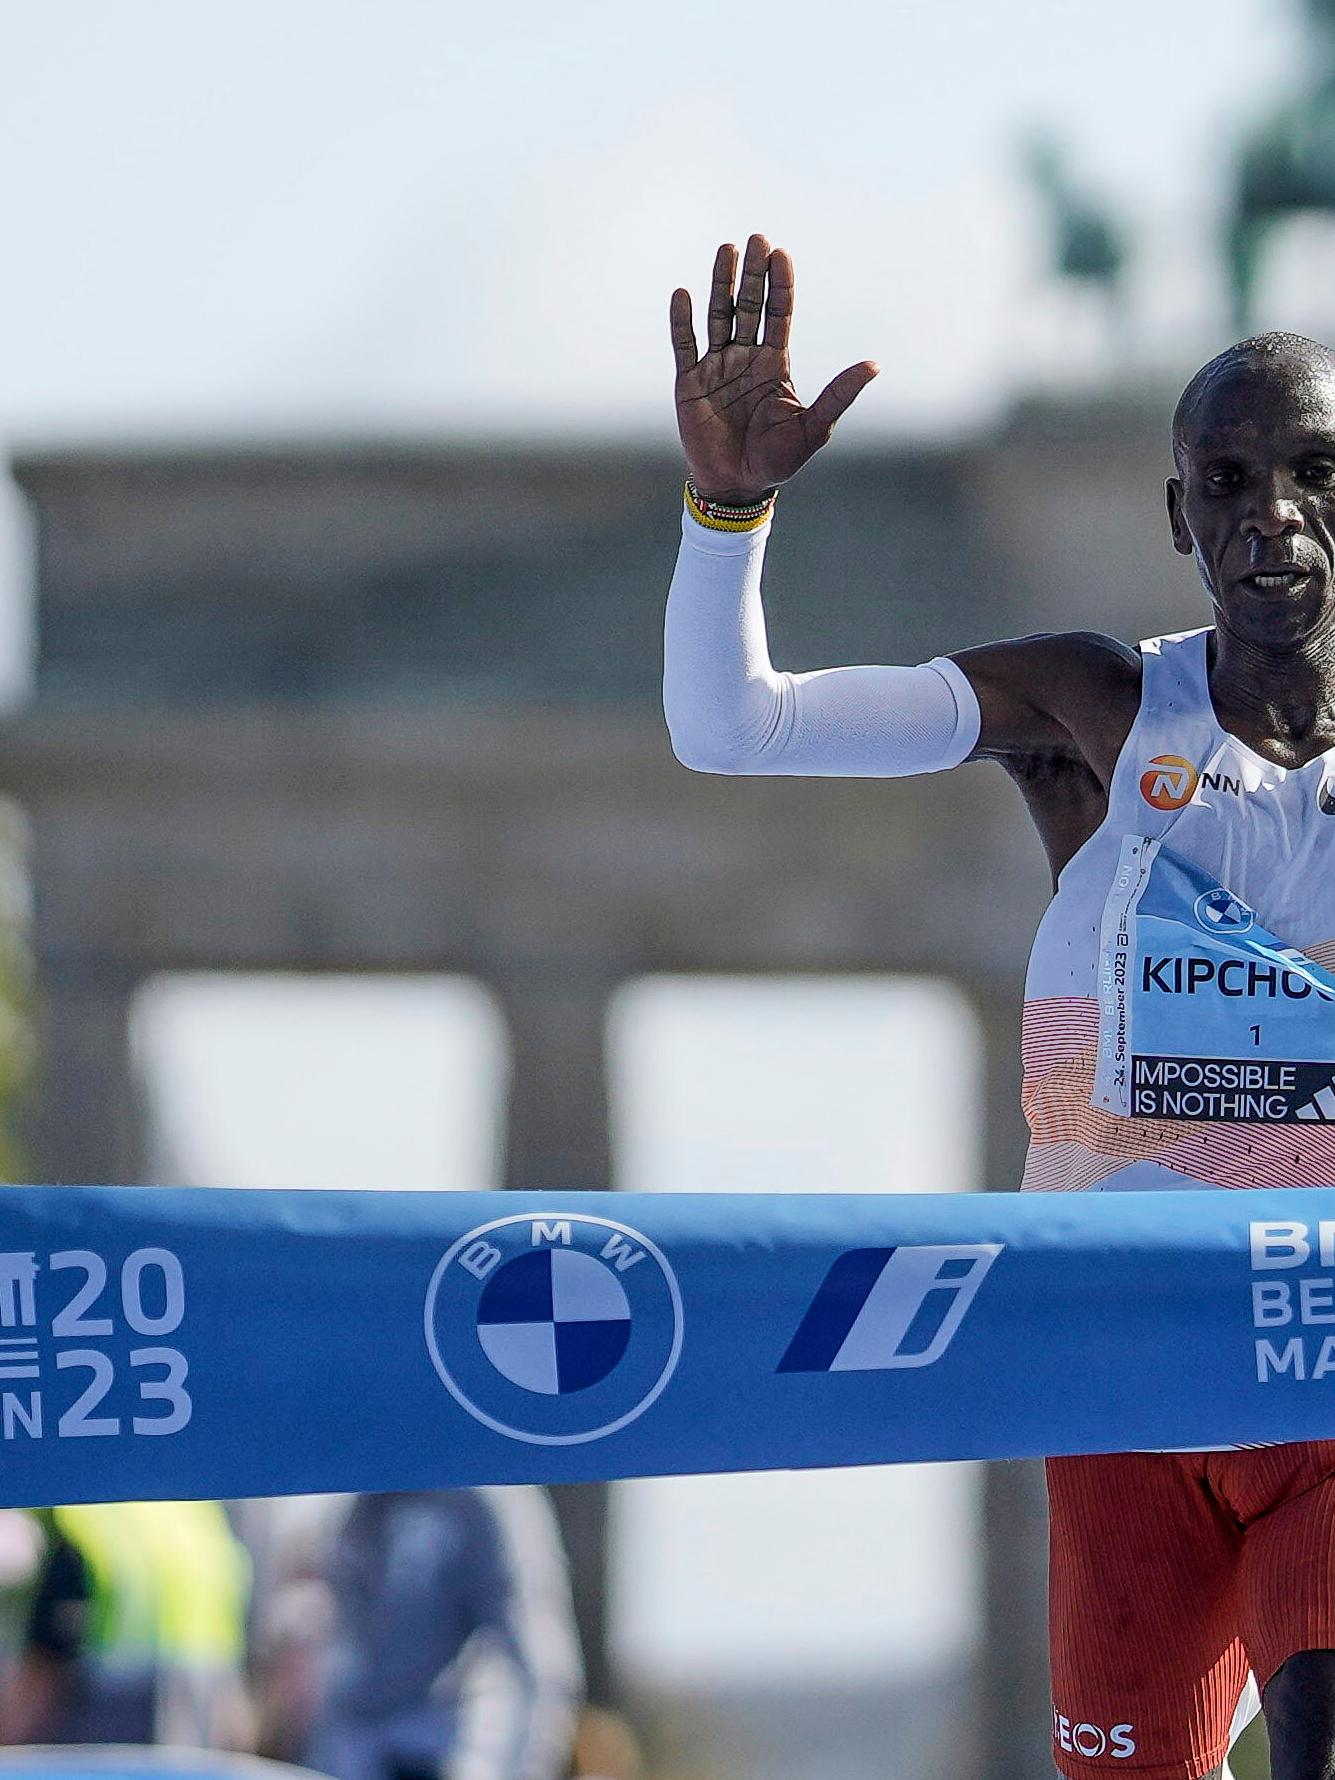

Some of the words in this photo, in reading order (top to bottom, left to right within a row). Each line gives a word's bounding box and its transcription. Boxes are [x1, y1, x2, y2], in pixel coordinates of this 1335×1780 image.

[1201, 772, 1241, 797] NN
[1114, 952, 1127, 986] 2023
[1142, 956, 1334, 1002] KIPCHO
[1114, 988, 1127, 1062] September
[1249, 1024, 1261, 1046] 1
[1134, 1060, 1297, 1091] IMPOSSIBLE
[1134, 1090, 1157, 1113] IS
[1162, 1090, 1289, 1119] NOTHING
[458, 1220, 649, 1282] BMW
[50, 1247, 186, 1337] 20
[57, 1346, 194, 1438] 23
